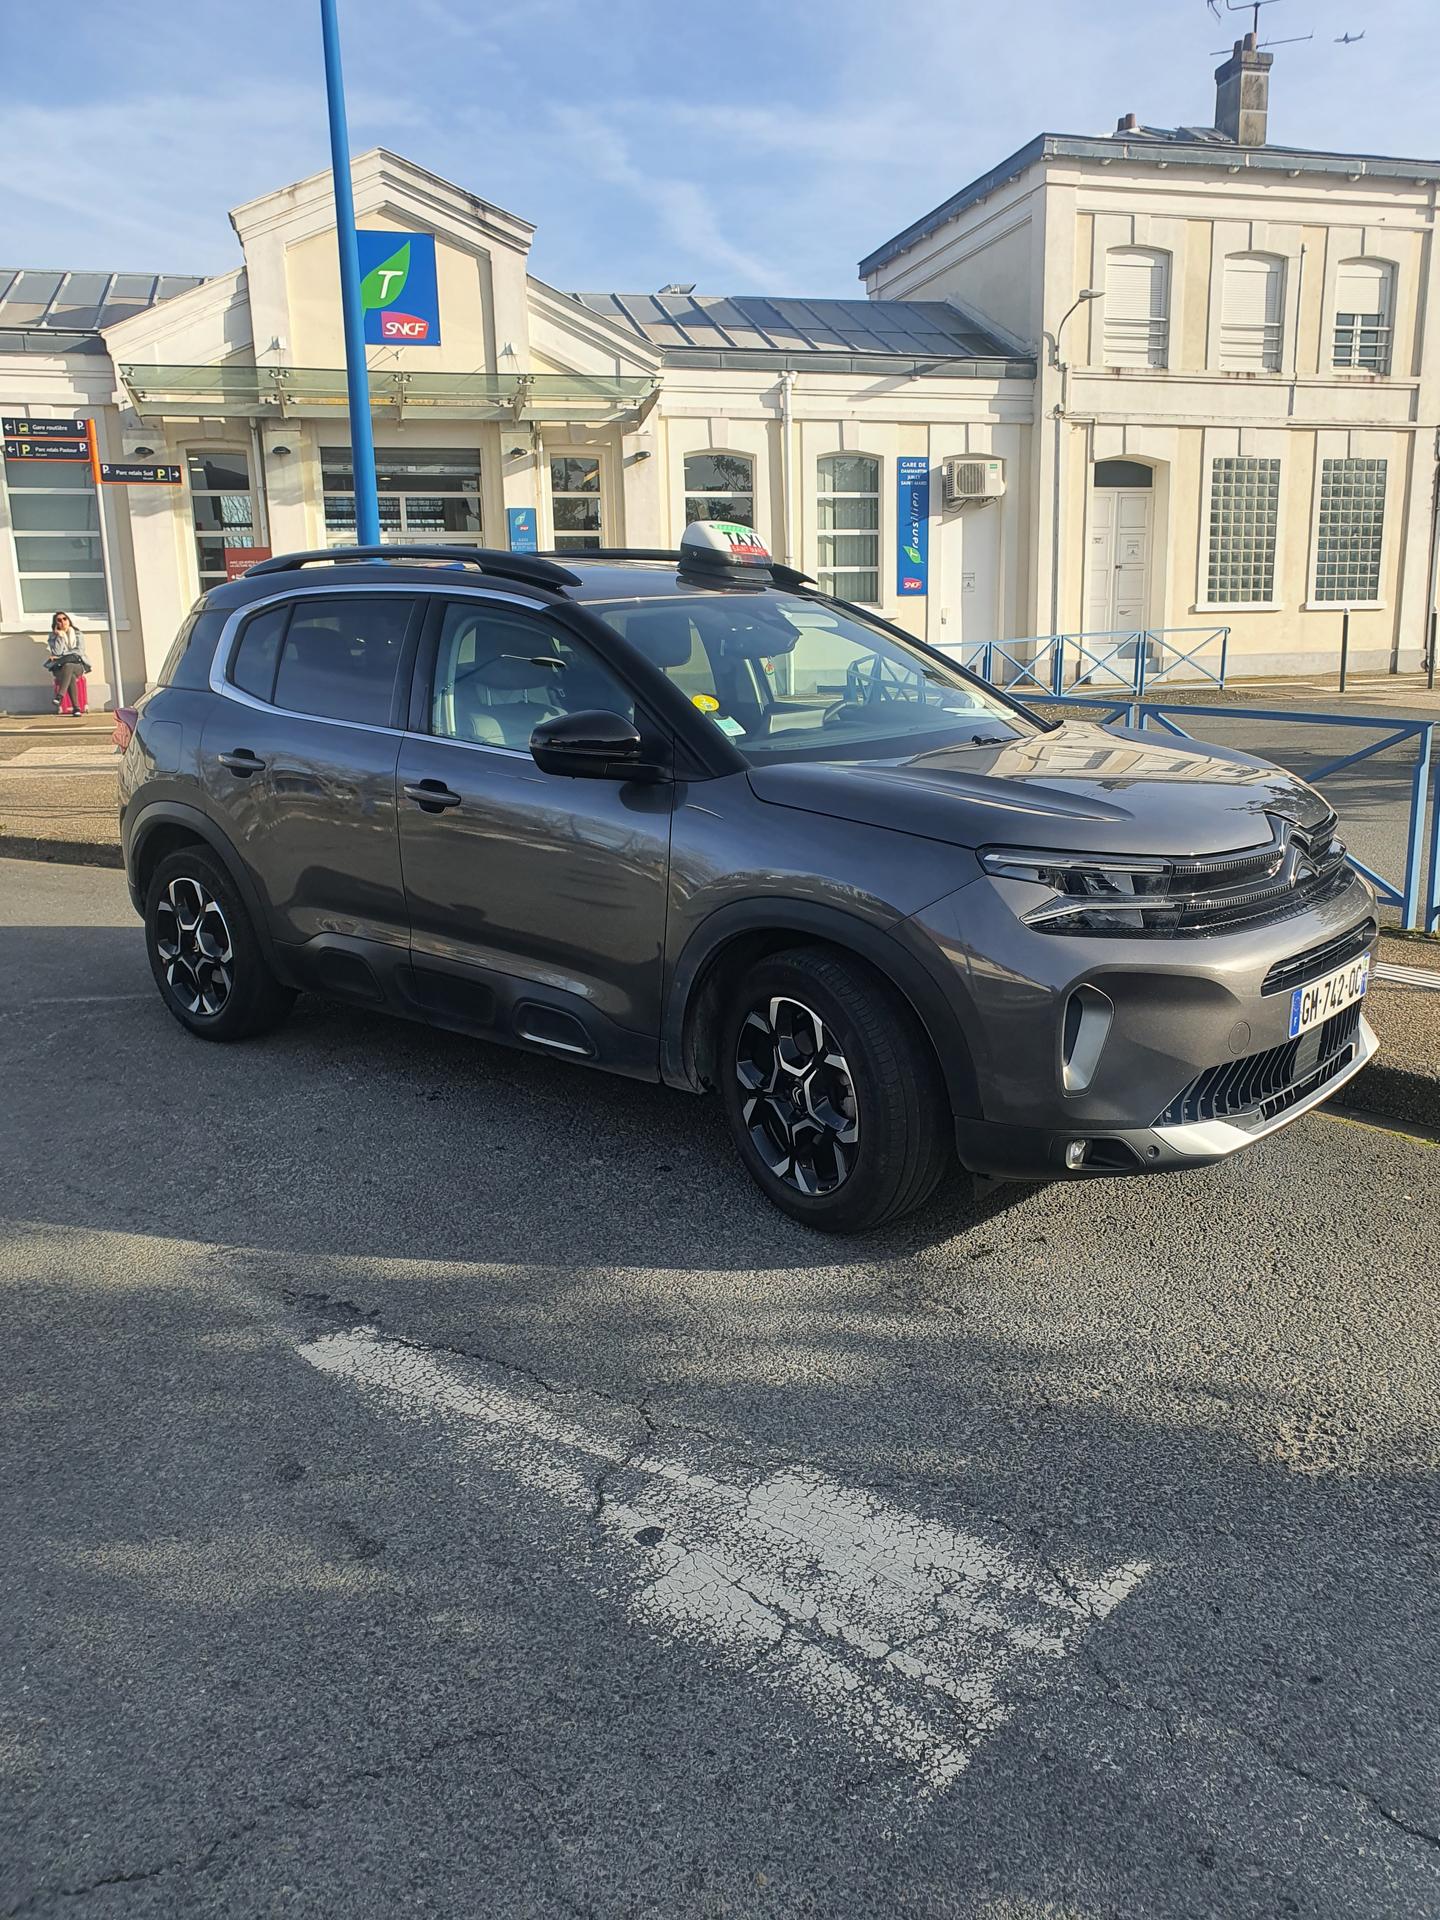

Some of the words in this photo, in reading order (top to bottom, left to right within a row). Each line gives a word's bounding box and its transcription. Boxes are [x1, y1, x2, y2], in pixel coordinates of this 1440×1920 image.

[377, 270, 404, 299] T
[384, 321, 427, 336] SNCF
[722, 531, 764, 549] TAXI
[903, 581, 921, 589] SNCF
